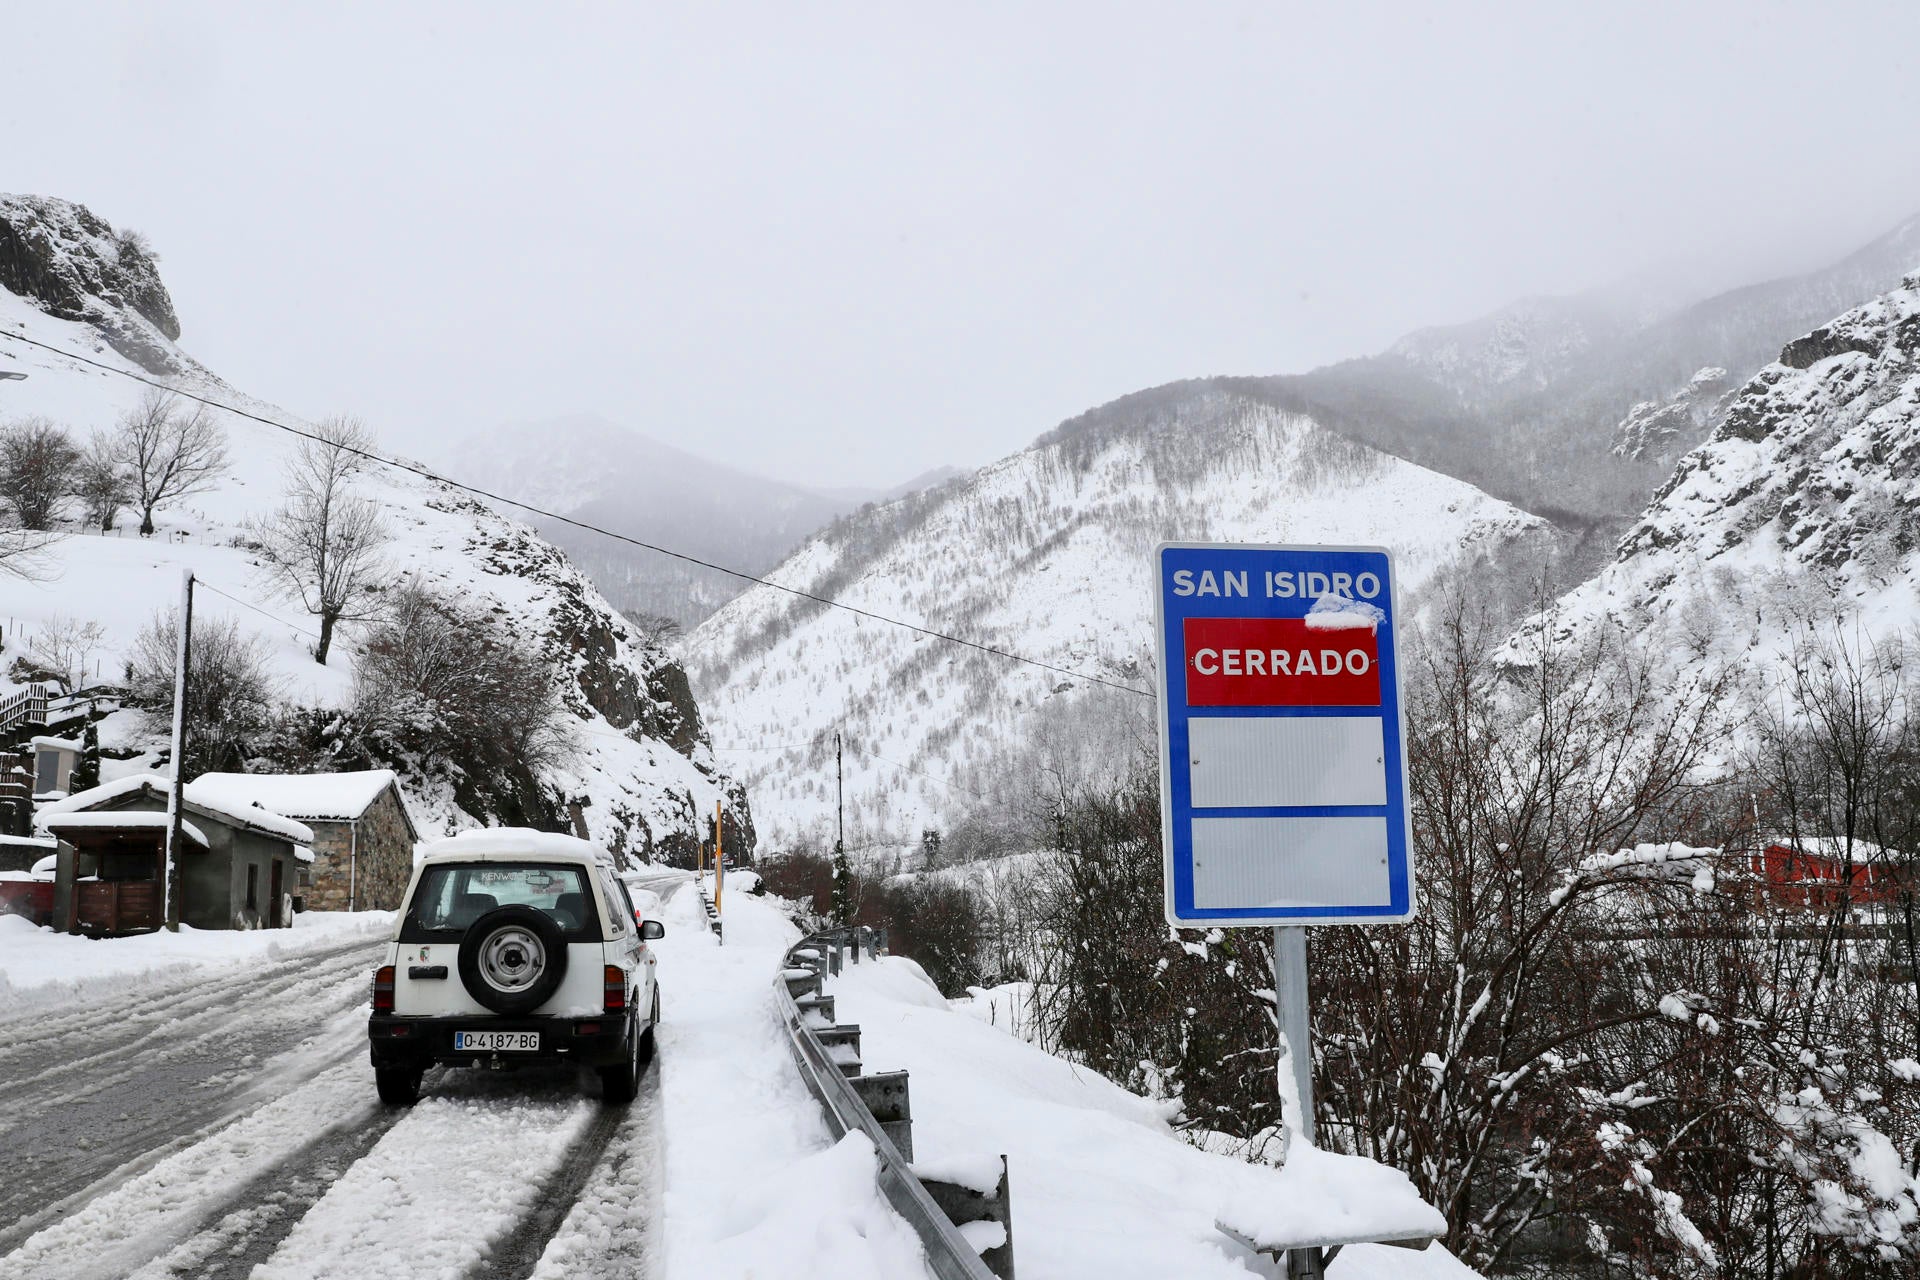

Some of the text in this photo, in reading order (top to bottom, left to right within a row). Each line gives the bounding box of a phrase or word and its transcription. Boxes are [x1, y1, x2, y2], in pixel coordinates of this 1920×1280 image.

[1173, 570, 1381, 599] SAN ISIDRO
[1194, 648, 1370, 676] CERRADO
